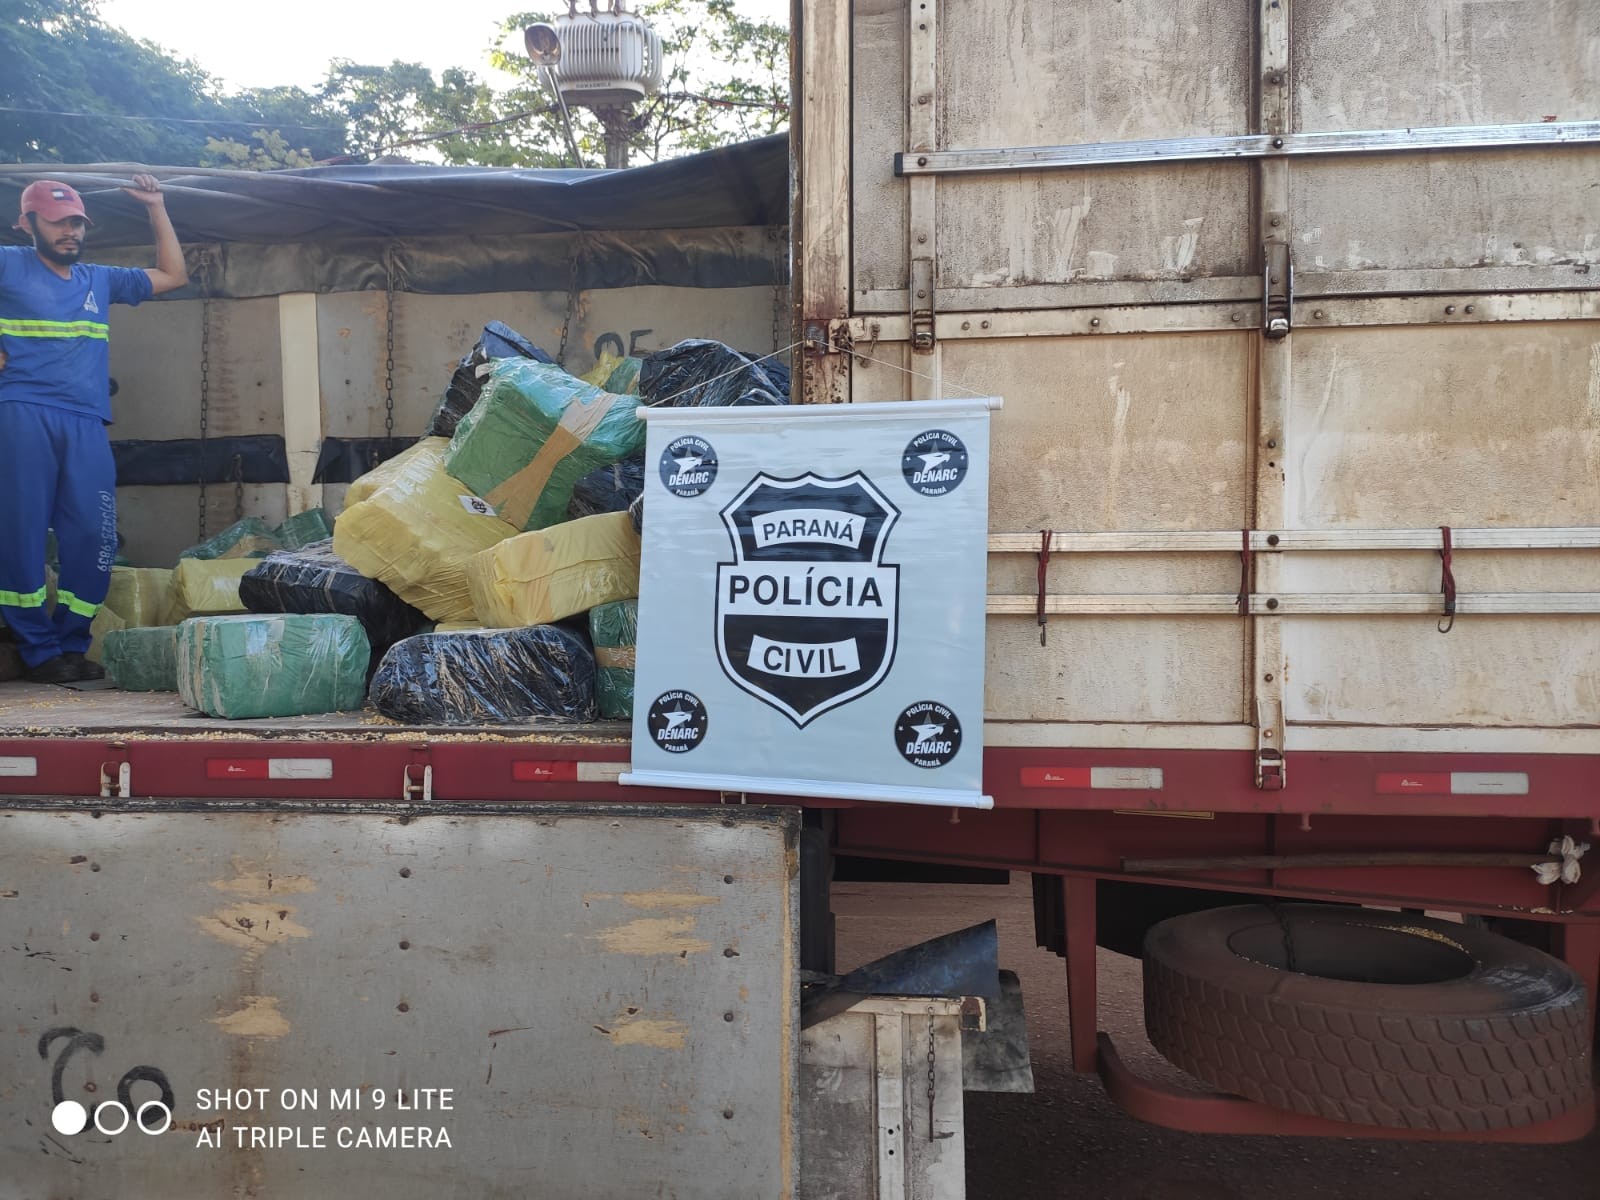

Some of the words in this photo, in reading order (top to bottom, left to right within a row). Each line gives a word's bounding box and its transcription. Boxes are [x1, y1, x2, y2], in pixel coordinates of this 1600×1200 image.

[669, 437, 694, 452] POLÍCIA
[694, 439, 709, 452] CIVIL
[913, 432, 940, 448] POLÍCIA
[941, 433, 958, 447] CIVIL
[668, 471, 709, 486] DENARC
[912, 467, 958, 484] DENARC
[762, 518, 854, 542] PARANÁ
[729, 566, 883, 607] POLÍCIA
[763, 645, 846, 674] CIVIL
[658, 691, 683, 705] POLÍCIA
[684, 693, 700, 708] CIVIL
[905, 703, 933, 718] POLÍCIA
[934, 705, 952, 720] CIVIL
[657, 727, 699, 740] DENARC
[905, 740, 952, 754] DENARC
